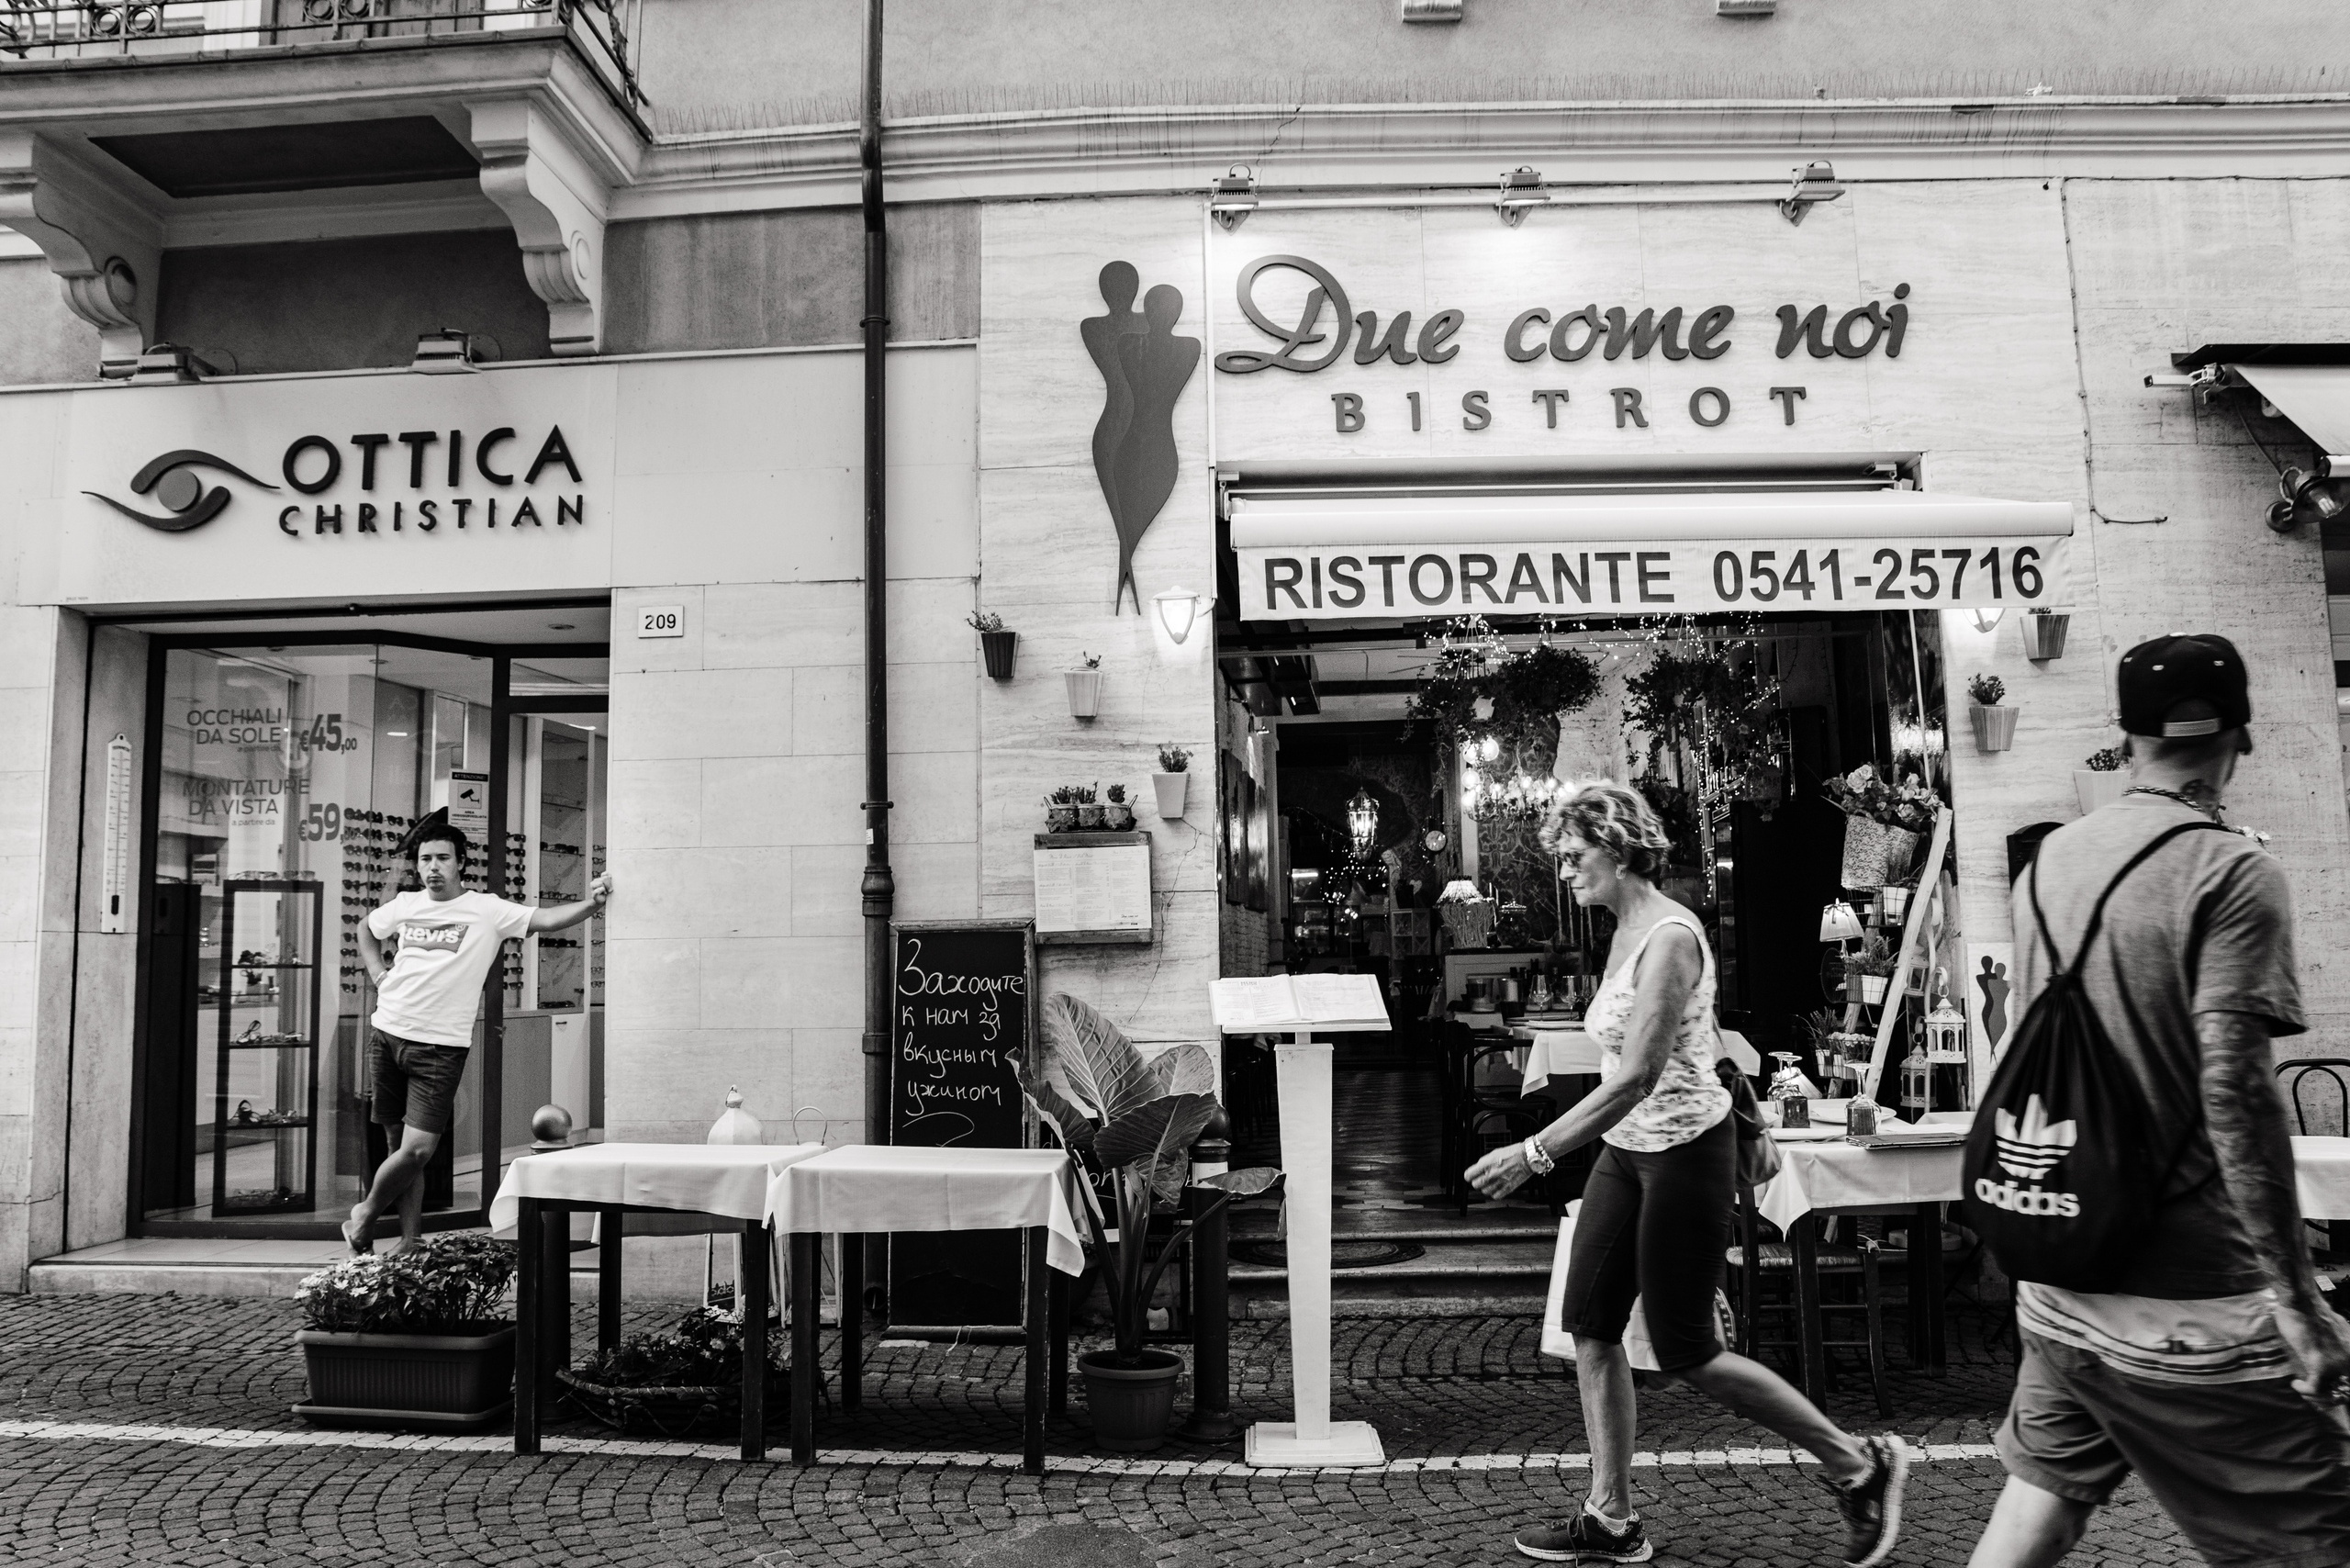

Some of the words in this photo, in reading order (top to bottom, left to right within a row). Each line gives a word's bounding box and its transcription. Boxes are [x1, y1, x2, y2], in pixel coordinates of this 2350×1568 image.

[1214, 253, 1462, 374] Due
[1503, 303, 1733, 362] come
[1775, 282, 1911, 359] noi
[1331, 385, 1808, 434] BISTROT
[282, 423, 583, 495] OTTICA
[279, 494, 584, 536] CHRISTIAN
[1263, 551, 1676, 611] RISTORANTE
[1712, 545, 2045, 602] 0541-25716
[644, 613, 677, 630] 209
[186, 708, 282, 725] OCCHIALI
[196, 728, 224, 745] DA
[229, 727, 281, 744] SOLE
[184, 779, 310, 797] MONTATURE
[189, 801, 216, 816] DA
[221, 799, 278, 814] VISTA
[239, 818, 263, 827] partire
[899, 938, 1024, 1011] Заходите
[926, 1007, 968, 1025] нам
[979, 1011, 1001, 1041] за
[903, 1031, 997, 1079] вкусным
[905, 1080, 1001, 1116] ужином
[1975, 1178, 2081, 1217] adidas
